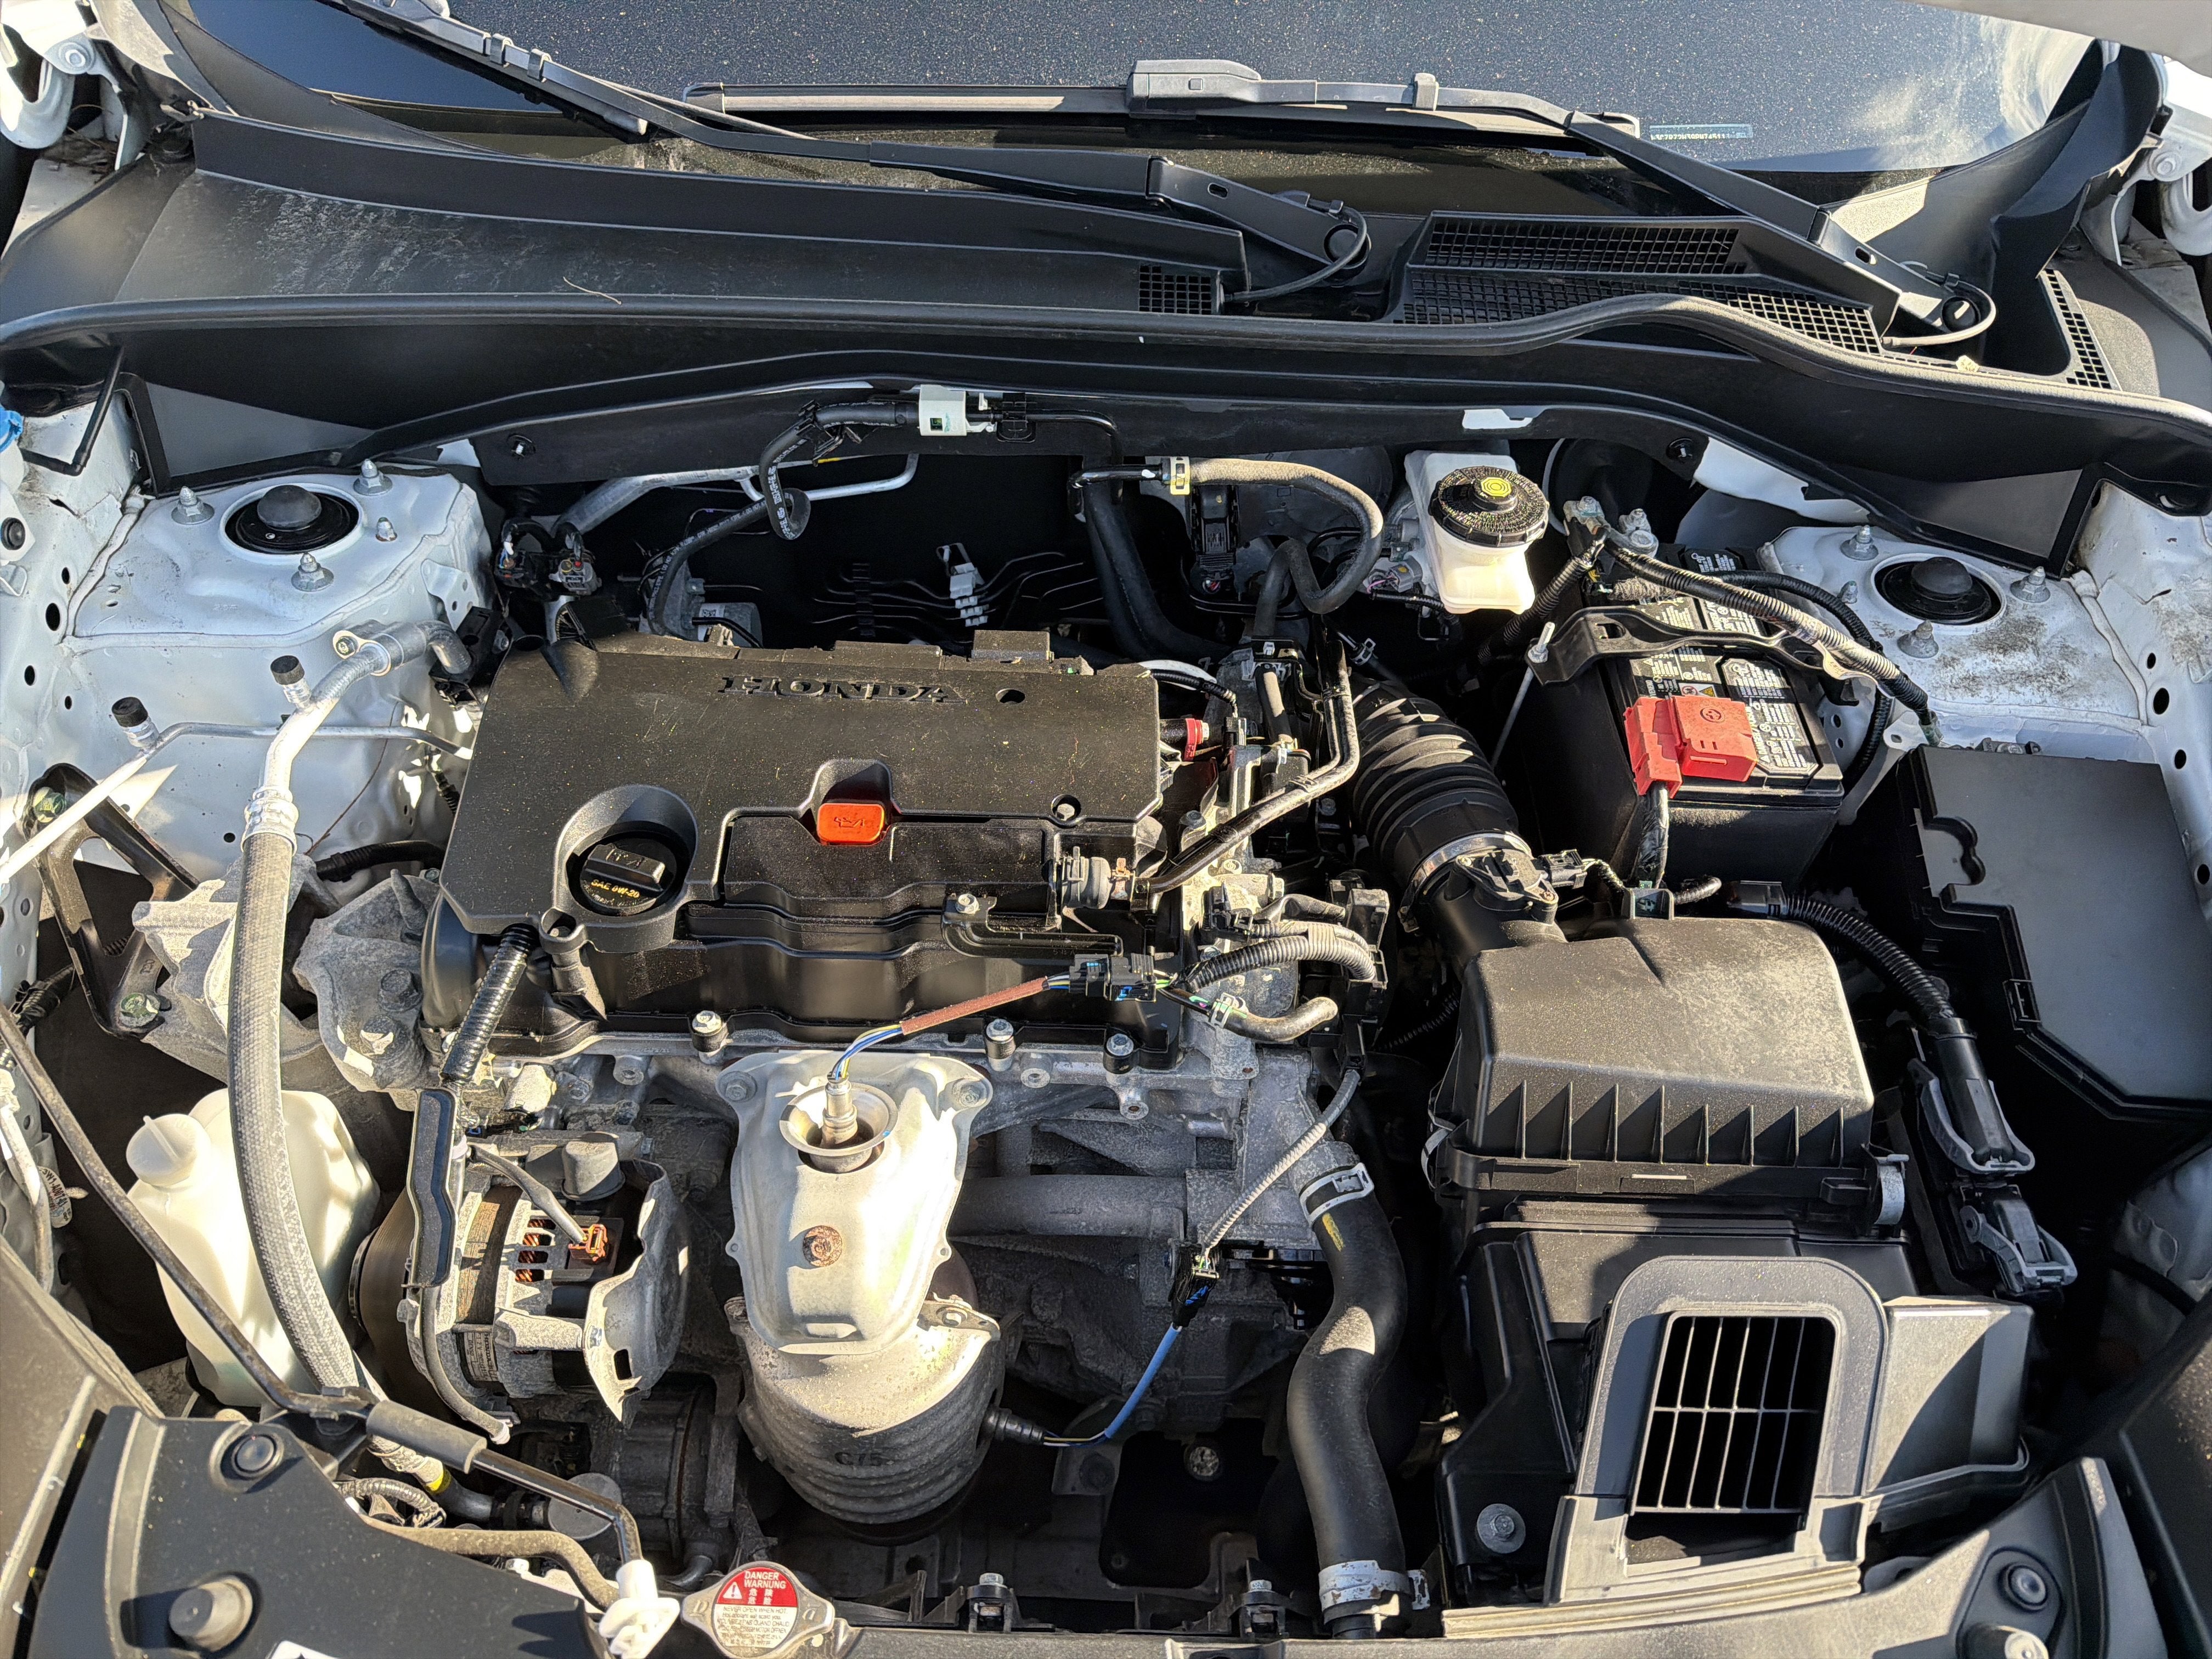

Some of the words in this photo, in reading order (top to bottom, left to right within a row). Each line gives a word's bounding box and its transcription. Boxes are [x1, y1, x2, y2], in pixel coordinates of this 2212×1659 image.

[718, 677, 968, 704] HONDA
[591, 879, 612, 890] SAE
[612, 885, 640, 898] 0W-20
[744, 1571, 779, 1580] DANGER
[744, 1579, 786, 1589] WARNUNG
